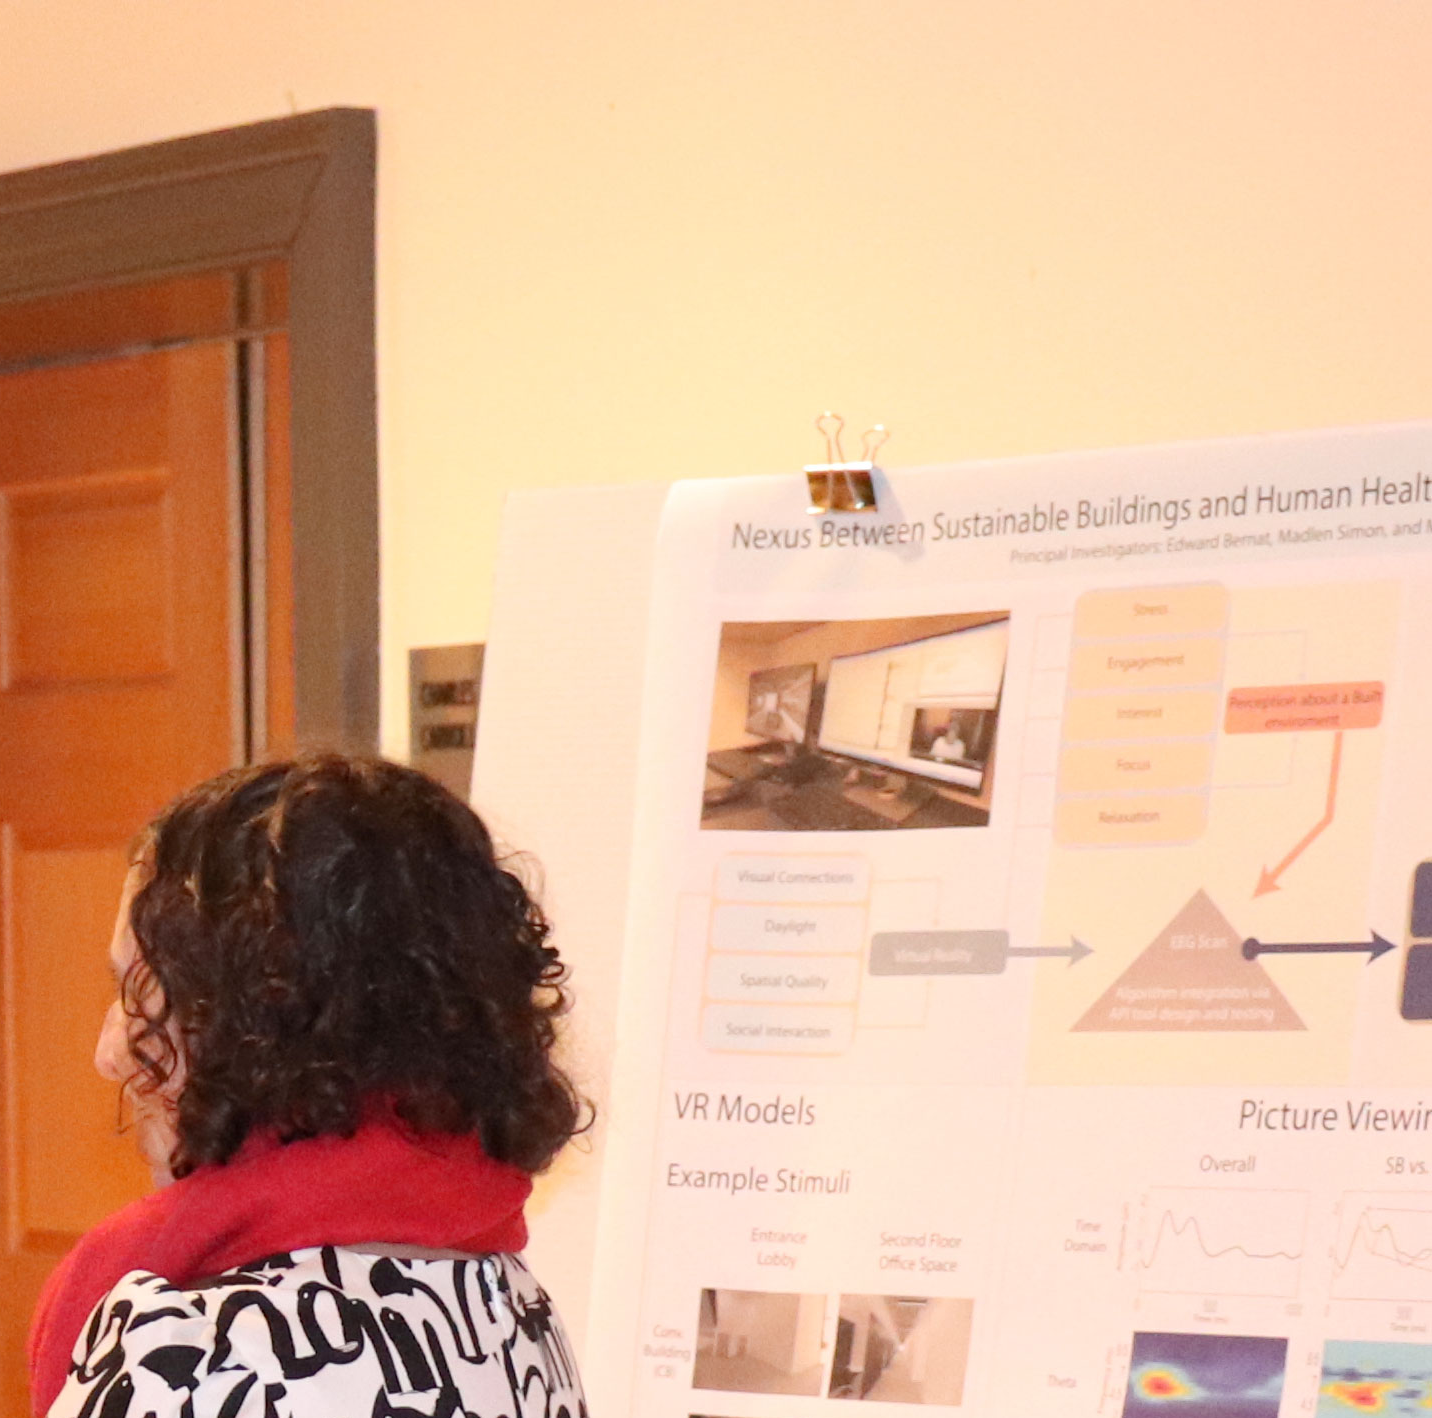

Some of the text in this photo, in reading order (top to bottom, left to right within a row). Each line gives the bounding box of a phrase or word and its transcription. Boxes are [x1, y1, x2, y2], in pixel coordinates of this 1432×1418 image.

[731, 472, 1432, 550] Nexus Between Sustainable Buildings and Human Healt
[1167, 535, 1219, 553] Edward
[1277, 527, 1333, 545] Madlen
[1392, 519, 1422, 536] and
[764, 918, 816, 936] Daylight
[674, 1092, 816, 1126] VR Models
[1239, 1100, 1432, 1132] Picture Viewi
[1199, 1154, 1257, 1174] Overall
[1385, 1156, 1429, 1175] SB vs.
[667, 1162, 852, 1195] Example Stimuli
[750, 1226, 808, 1245] Entrance
[880, 1231, 962, 1249] Second Floor
[756, 1251, 798, 1271] Lobby
[879, 1255, 958, 1275] Office Space
